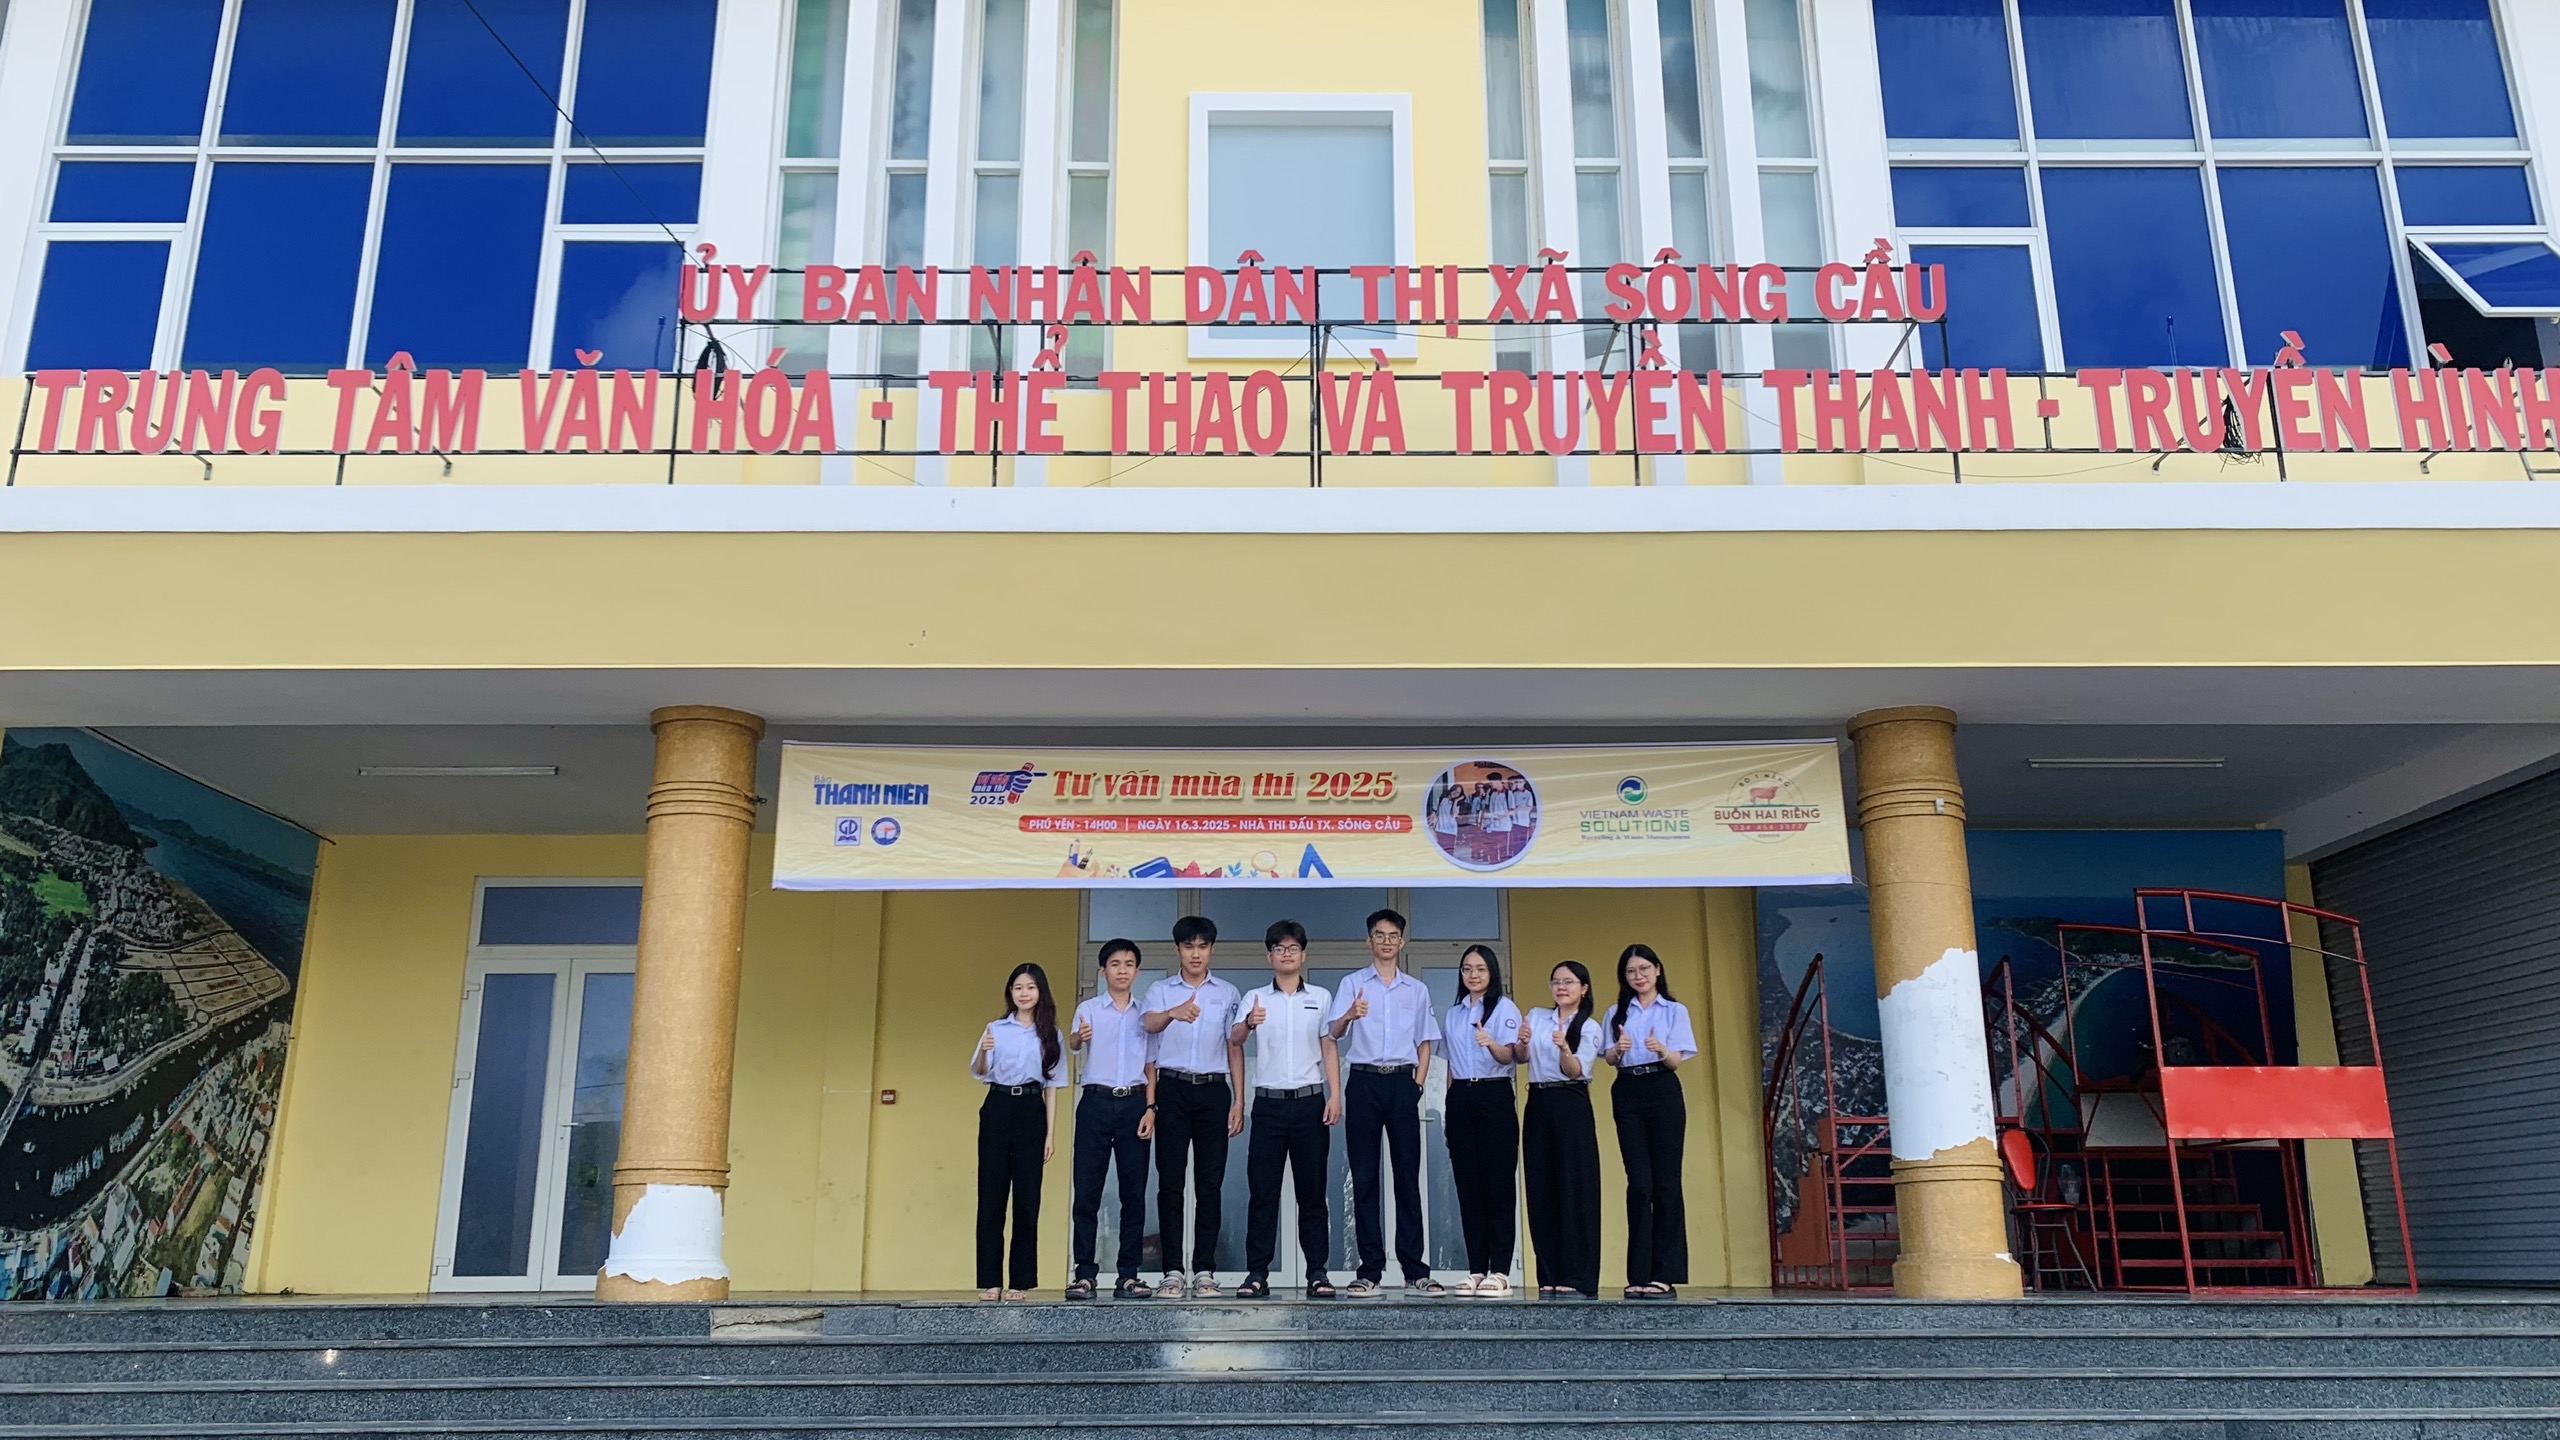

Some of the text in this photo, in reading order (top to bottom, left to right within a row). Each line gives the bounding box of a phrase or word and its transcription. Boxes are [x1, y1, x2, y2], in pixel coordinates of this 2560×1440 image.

[681, 238, 1947, 338] ỦY BAN NHÂN DÂN THỊ XÃ SÔNG CẦU
[35, 367, 287, 455] TRUNG
[327, 351, 487, 454] TÂM
[519, 348, 660, 454] VĂN
[691, 347, 837, 455] HÓA
[928, 324, 1067, 455] THỂ
[1098, 370, 1288, 456] THAO
[1318, 348, 1407, 455] VÀ
[1441, 329, 1727, 455] TRUYỀN
[1763, 368, 2015, 454] THANH
[2076, 330, 2371, 453] TRUYỀN
[2389, 343, 2560, 453] HÌNH
[1053, 769, 1394, 798] Tư vấn mùa thi 2025
[814, 782, 929, 805] THANH NIÊN
[969, 796, 1005, 805] 2025
[1580, 809, 1689, 819] VIETNAM WASTE
[1714, 806, 1820, 820] BUÔN HAI RIÊNG
[1029, 817, 1051, 829] PHÚ
[1055, 818, 1075, 829] YÊN
[1084, 820, 1117, 830] 14H00
[1137, 817, 1171, 830] NGÀY
[1175, 820, 1230, 830] 16.3.2025
[1239, 817, 1265, 830] NHÀ
[1268, 819, 1286, 830] THI
[1289, 816, 1314, 830] ĐẤU
[1316, 819, 1335, 830] TX.
[1337, 817, 1371, 830] SÔNG
[1374, 815, 1400, 830] CẦU
[1580, 820, 1690, 832] SOLUTIONS
